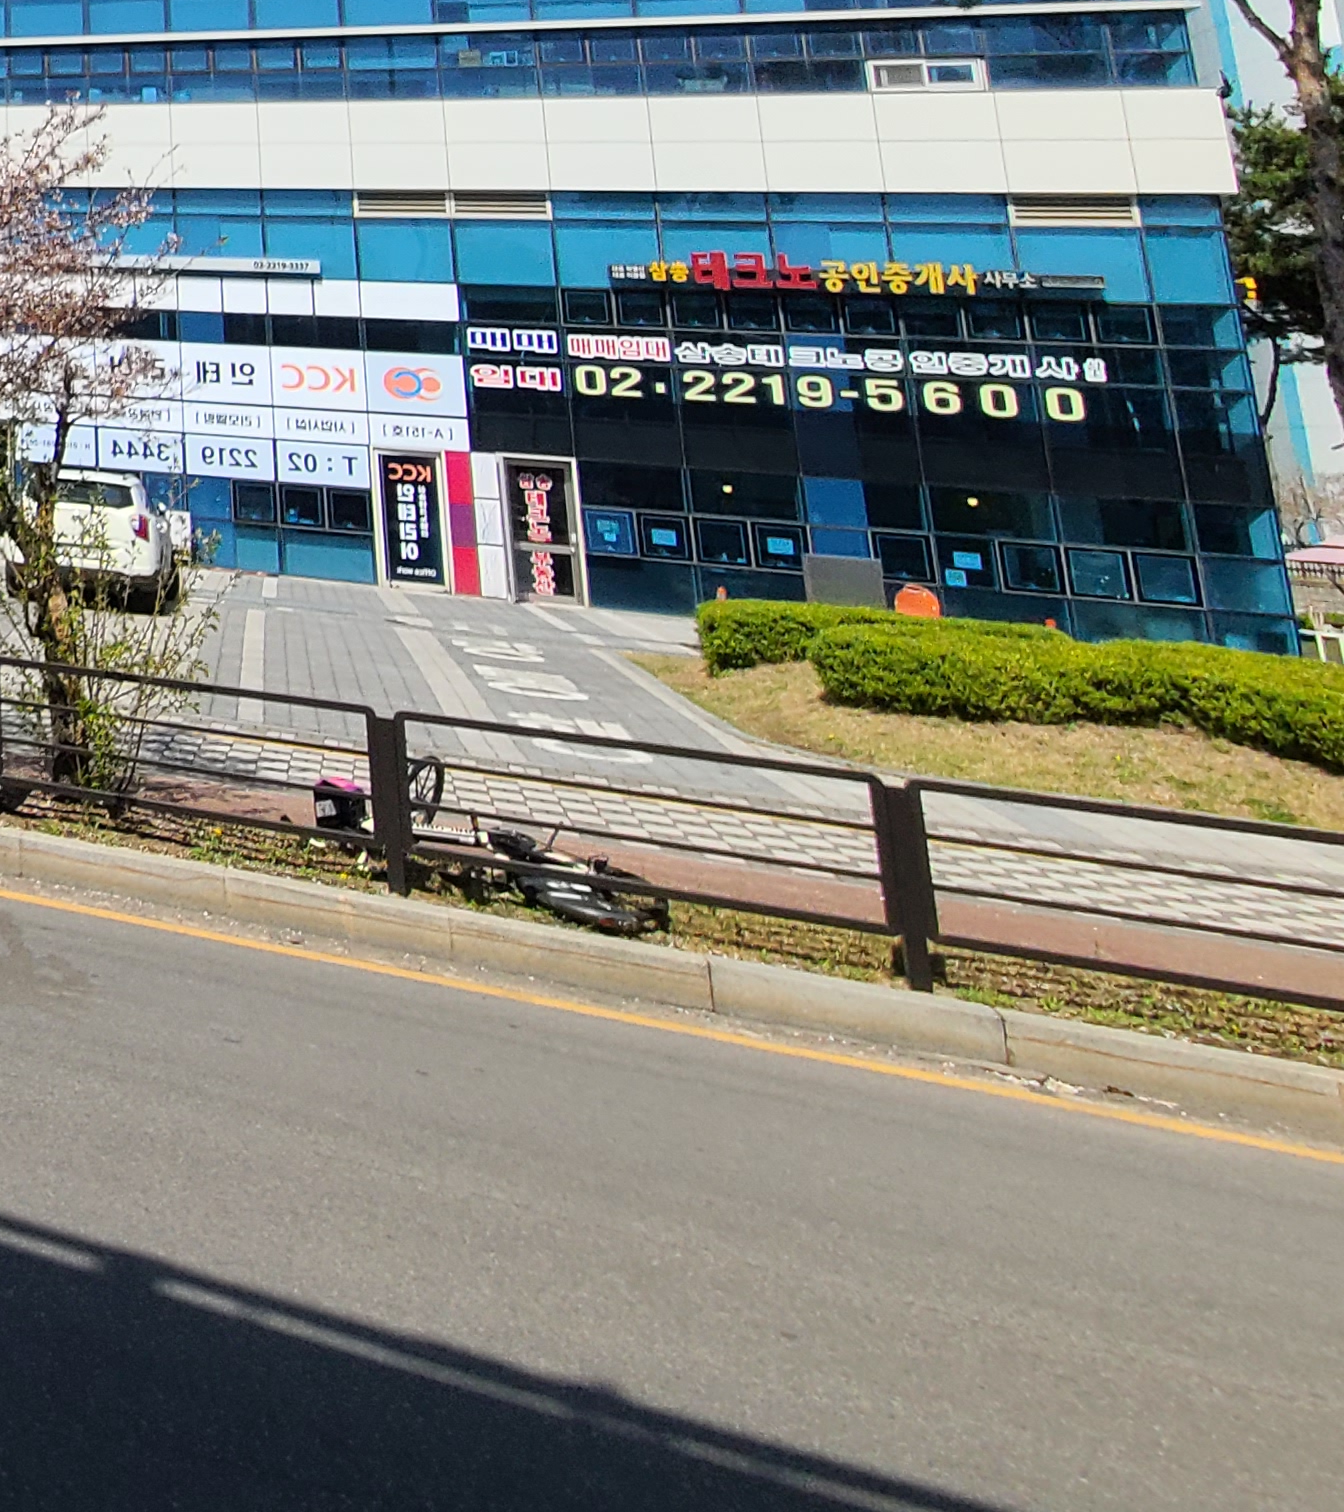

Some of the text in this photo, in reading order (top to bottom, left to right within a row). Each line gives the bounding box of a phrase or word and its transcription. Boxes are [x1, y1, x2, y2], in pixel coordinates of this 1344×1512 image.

[649, 260, 689, 283] 삼송
[690, 250, 818, 291] 테크노
[819, 260, 978, 295] 공인중개사
[568, 333, 672, 362] 매매임대
